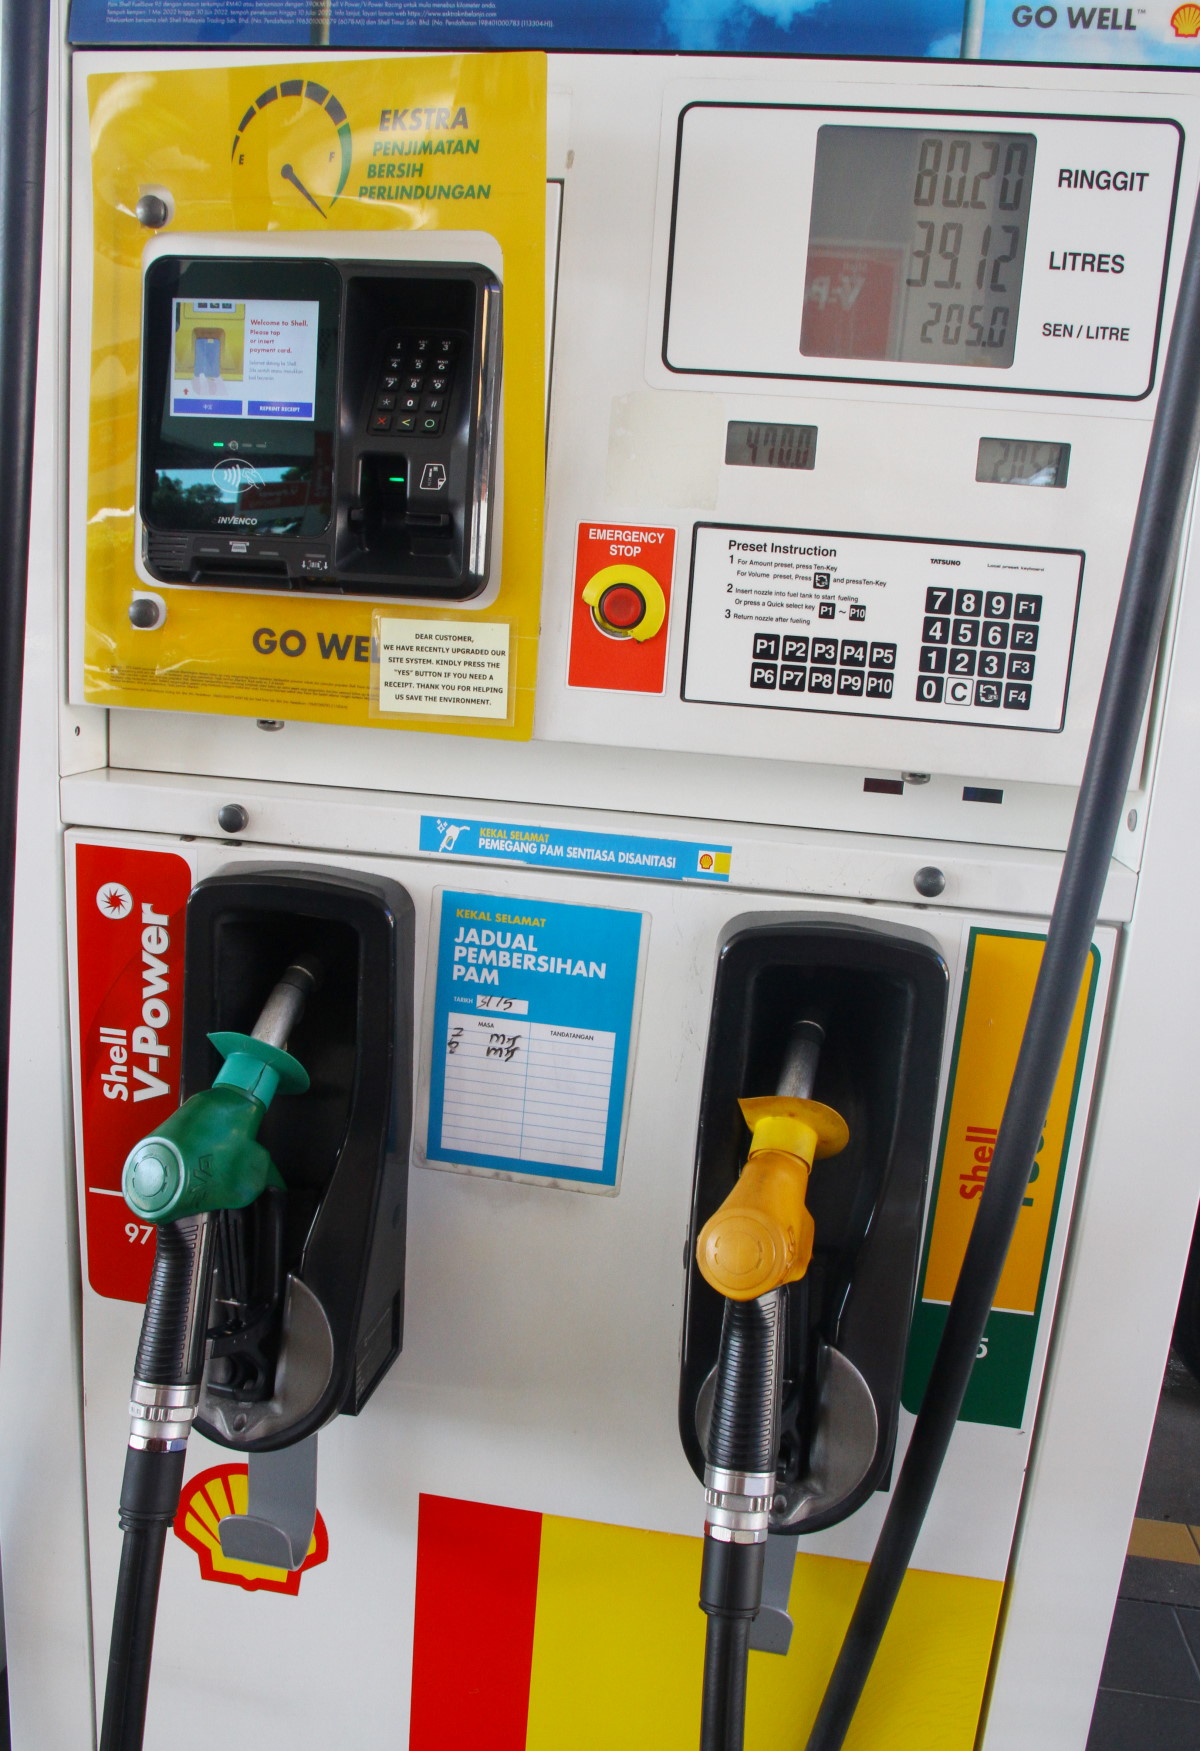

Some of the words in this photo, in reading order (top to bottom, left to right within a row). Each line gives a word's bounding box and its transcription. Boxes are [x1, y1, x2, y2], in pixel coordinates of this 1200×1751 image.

[1012, 5, 1058, 28] GO
[379, 108, 468, 131] EKSTRA
[239, 154, 244, 164] E
[329, 152, 334, 162] F
[372, 140, 480, 156] PENJIMATAN
[368, 164, 423, 178] BERSIH
[914, 139, 1029, 211] 80.20
[1058, 168, 1150, 192] RINGGIT
[359, 185, 491, 200] PERLINDUNGAN
[906, 221, 1020, 292] 39.12
[1049, 252, 1125, 274] LITRES
[1042, 323, 1073, 338] SEN
[1086, 326, 1129, 342] LITRE
[589, 529, 665, 544] EMERGENCY
[609, 545, 641, 556] STOP
[728, 540, 767, 553] Preset
[771, 542, 836, 557] Instruction
[730, 555, 733, 564] 1
[727, 584, 733, 592] 2
[846, 579, 887, 587] pressTen-Key
[725, 609, 731, 618] 3
[821, 606, 832, 615] P1
[850, 608, 864, 618] P10
[933, 591, 946, 610] 7
[962, 594, 975, 612] 8
[991, 596, 1005, 614] 9
[1019, 602, 1035, 614] F1
[252, 628, 306, 657] GO
[929, 622, 942, 640] 4
[958, 624, 972, 642] 5
[988, 626, 1002, 645] 6
[1016, 631, 1033, 644] F2
[756, 639, 775, 654] P1
[785, 642, 806, 656] P2
[814, 644, 835, 658] P3
[843, 646, 864, 661] P4
[872, 648, 893, 663] P5
[928, 651, 936, 669] 1
[955, 653, 969, 672] 2
[985, 656, 998, 674] 3
[1012, 661, 1029, 673] F3
[753, 669, 774, 683] P6
[782, 671, 804, 685] P7
[811, 673, 832, 688] P8
[840, 675, 861, 690] P9
[868, 678, 892, 693] P10
[923, 680, 936, 699] 0
[951, 683, 967, 701] C
[1009, 690, 1026, 703] F4
[440, 697, 491, 705] ENVIRONMENT.
[480, 828, 508, 840] KEKAL
[510, 831, 549, 843] SELAMAT
[478, 839, 537, 854] PEMEGANG
[539, 844, 563, 856] PAM
[566, 847, 615, 863] SENTIASA
[618, 852, 676, 868] DISANITASI
[456, 909, 492, 921] KEKAL
[495, 913, 547, 927] SELAMAT
[454, 927, 537, 952] JADUAL
[454, 946, 606, 979] PEMBERSIHAN
[452, 964, 499, 985] PAM
[132, 902, 170, 1103] V-Power
[550, 1031, 594, 1041] TANDATANGAN
[100, 1027, 128, 1102] Shell
[960, 1126, 998, 1201] Shell
[124, 1223, 153, 1245] 97
